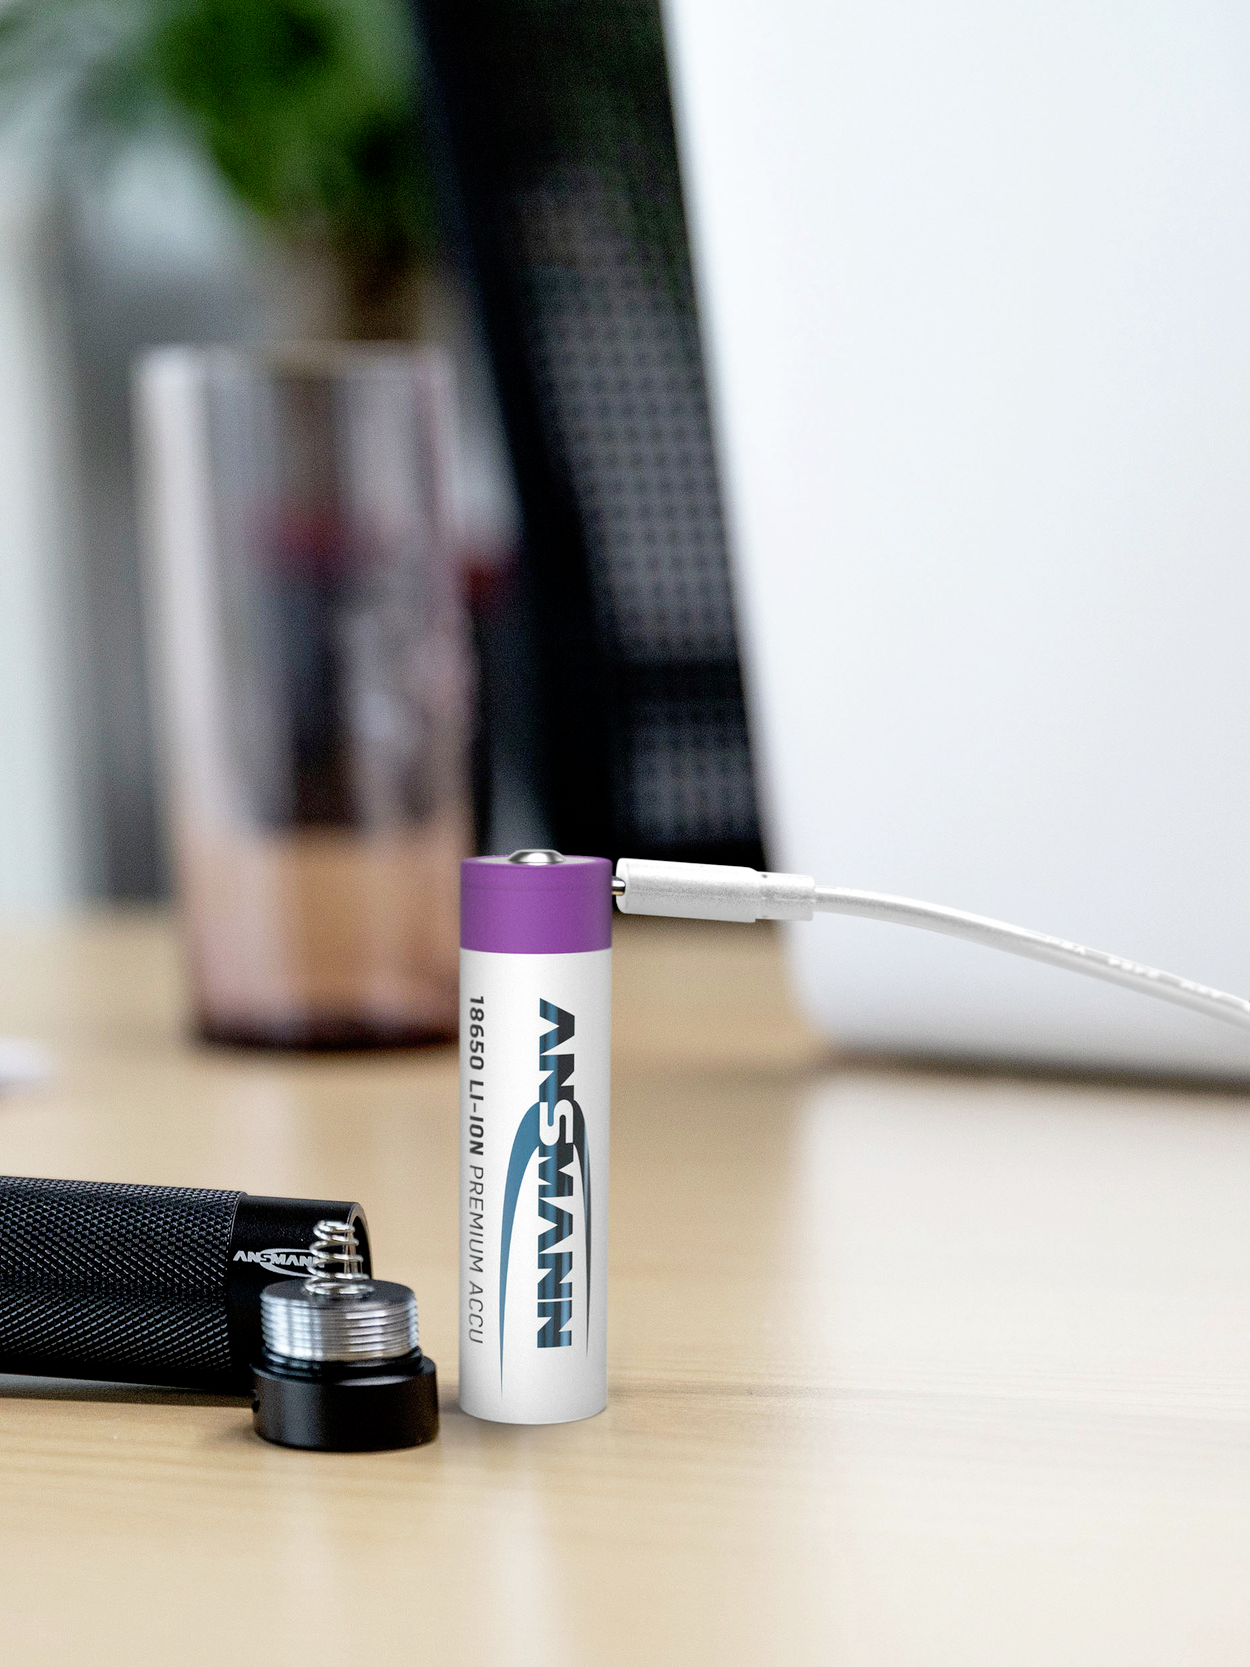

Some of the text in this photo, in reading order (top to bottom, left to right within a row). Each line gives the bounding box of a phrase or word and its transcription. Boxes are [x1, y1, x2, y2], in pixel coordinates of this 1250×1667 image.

[469, 996, 484, 1344] 18650 LI-ION PREMIUM ACCU
[537, 997, 575, 1348] ANSMANN
